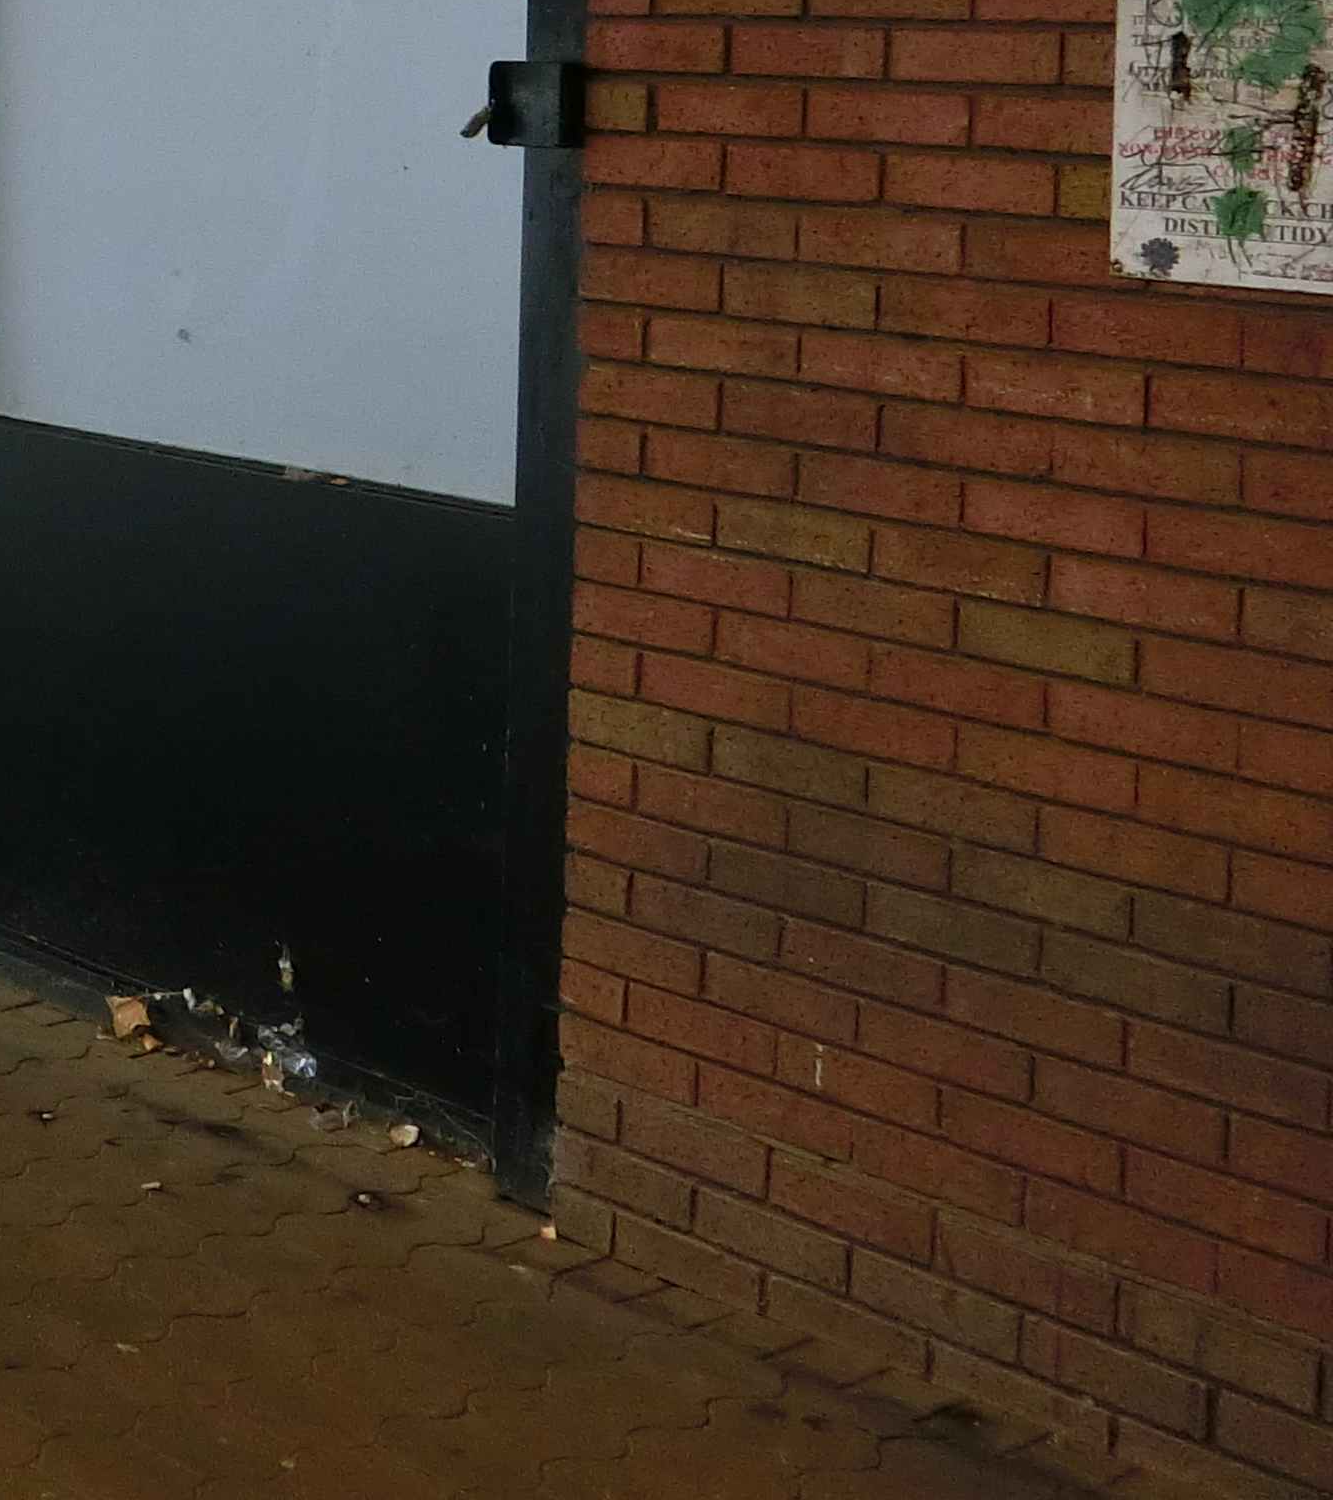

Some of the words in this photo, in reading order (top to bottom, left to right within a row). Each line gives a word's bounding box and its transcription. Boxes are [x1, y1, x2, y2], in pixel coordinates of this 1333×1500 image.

[1120, 190, 1178, 209] KEEP
[1181, 195, 1296, 218] CACK
[1277, 224, 1330, 245] TIDY
